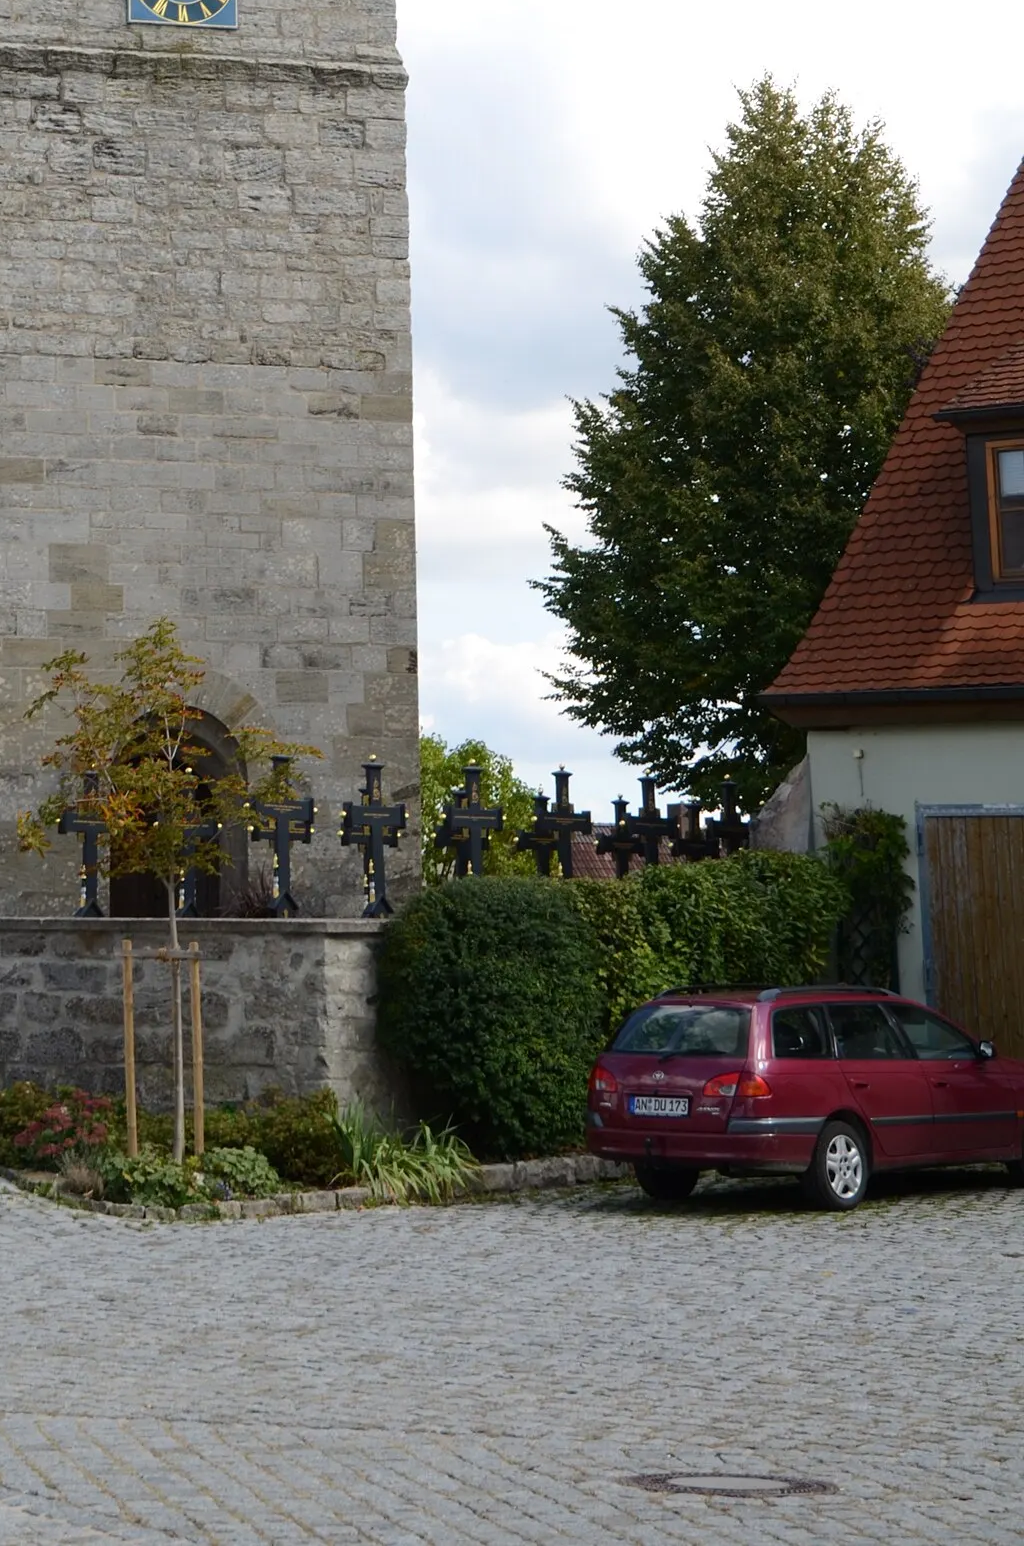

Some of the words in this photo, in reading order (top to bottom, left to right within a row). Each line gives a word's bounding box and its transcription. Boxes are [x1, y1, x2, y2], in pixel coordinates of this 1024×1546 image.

[178, 4, 189, 22] VI
[200, 1, 212, 18] V
[635, 1098, 649, 1110] AN
[654, 1098, 667, 1111] DU
[669, 1099, 687, 1112] 173
